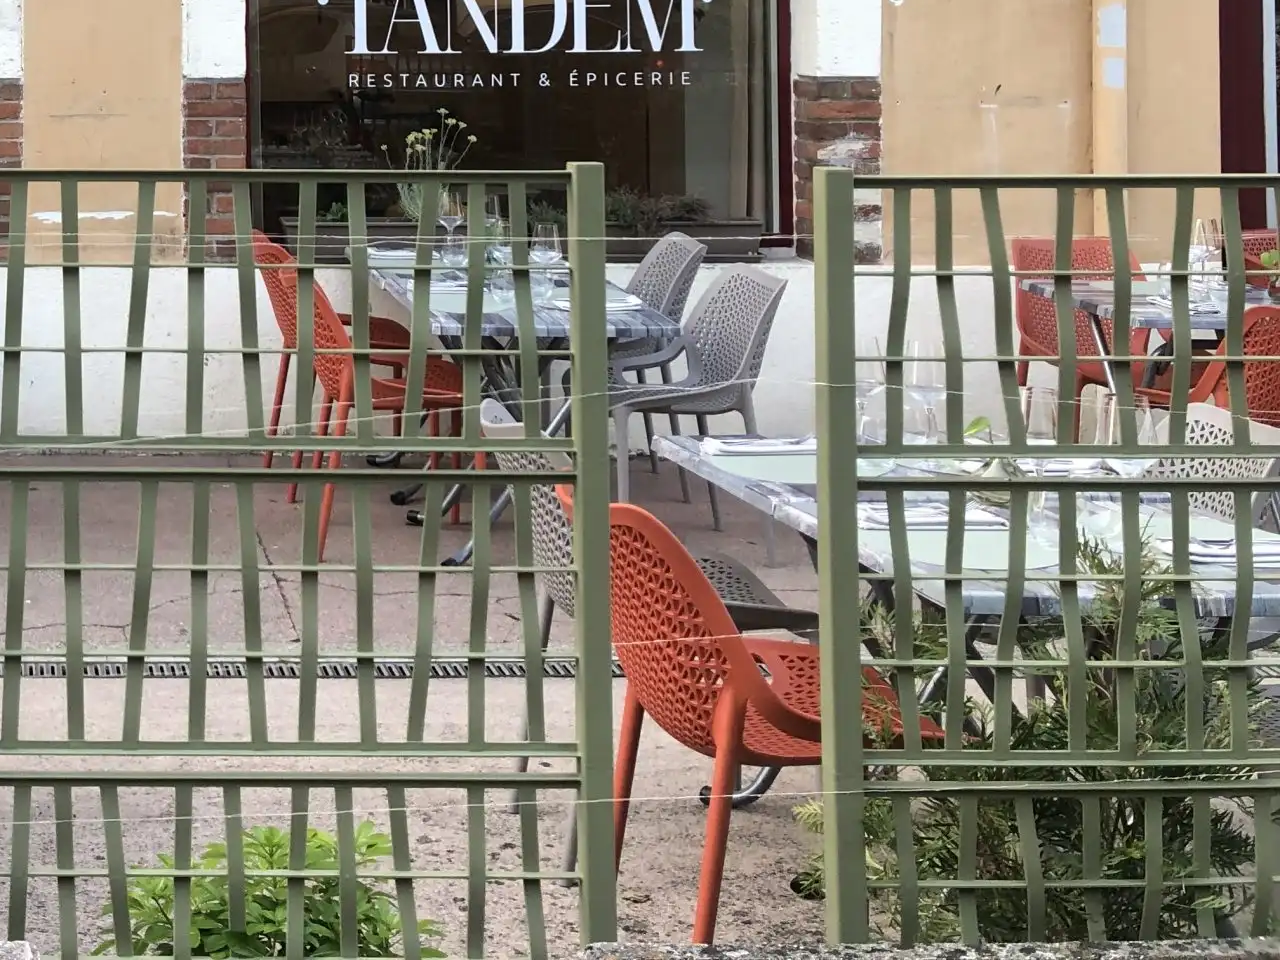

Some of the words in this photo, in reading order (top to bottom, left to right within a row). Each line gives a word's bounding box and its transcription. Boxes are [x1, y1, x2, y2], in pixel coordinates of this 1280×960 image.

[348, 72, 521, 87] RESTAURANT
[539, 72, 551, 87] &
[569, 69, 693, 87] ÉPICERIE
